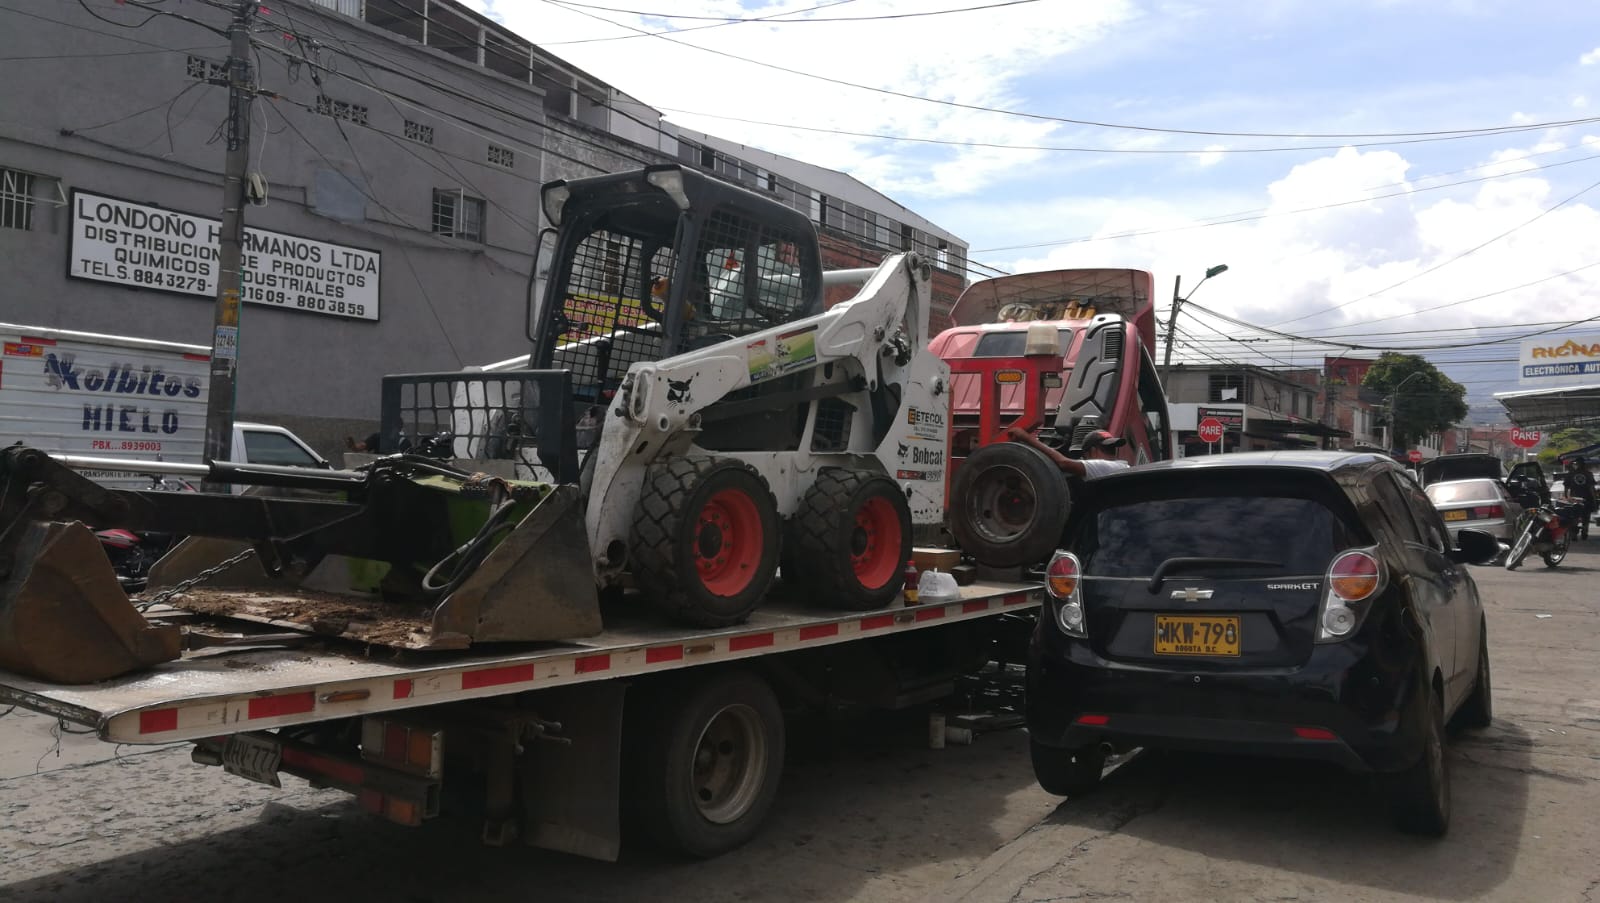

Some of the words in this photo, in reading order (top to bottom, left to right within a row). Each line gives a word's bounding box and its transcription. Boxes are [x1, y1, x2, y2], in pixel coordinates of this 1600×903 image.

[78, 198, 197, 239] LONDOÑO
[208, 224, 321, 263] HRMANOS
[331, 249, 377, 274] LTDA
[85, 225, 221, 261] DISTRIBUCION
[272, 260, 366, 287] PRODUCTOS
[115, 247, 210, 276] QUIMICOS
[242, 270, 344, 298] DUSTRIALES
[297, 295, 365, 316] 8803859
[1525, 364, 1580, 376] ELECTRÓNICA
[82, 403, 179, 434] HIELO
[1200, 425, 1221, 435] PARE
[1512, 431, 1539, 440] PARE
[912, 446, 943, 466] Bobcat
